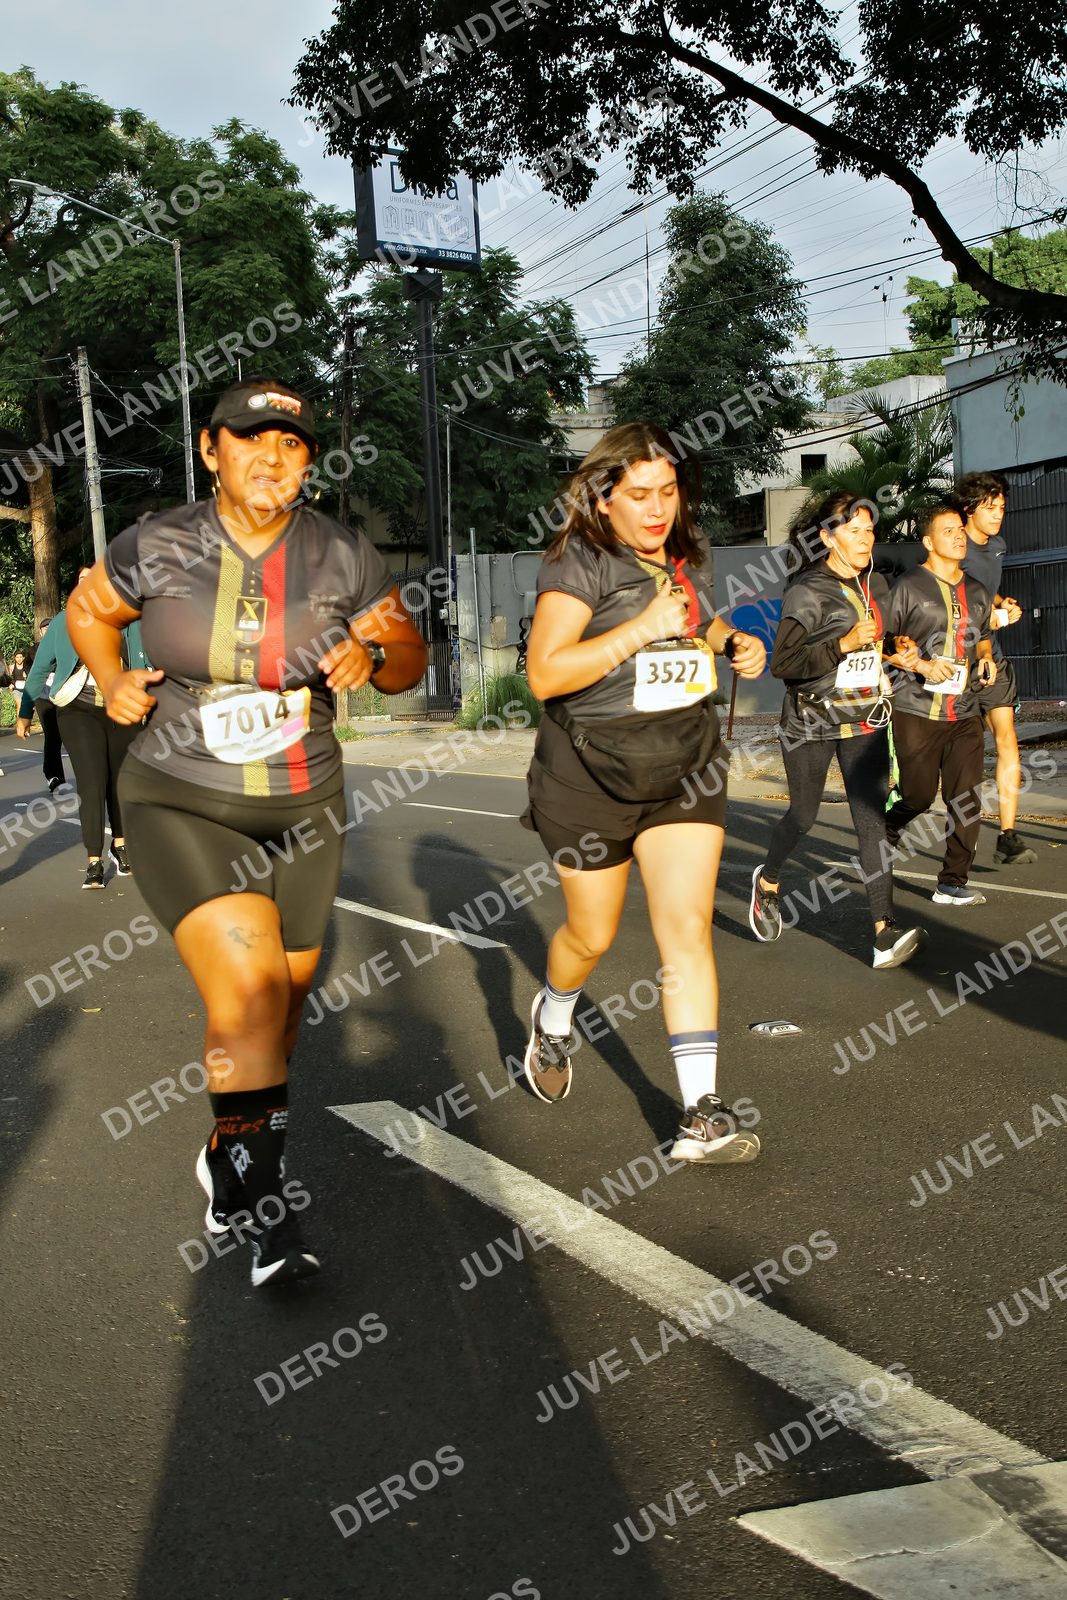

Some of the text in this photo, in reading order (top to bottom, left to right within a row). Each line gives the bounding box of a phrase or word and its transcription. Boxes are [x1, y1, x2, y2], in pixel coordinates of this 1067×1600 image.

[438, 249, 446, 257] 33
[647, 660, 699, 684] 3527
[846, 656, 875, 673] 5157
[217, 699, 290, 739] 7014
